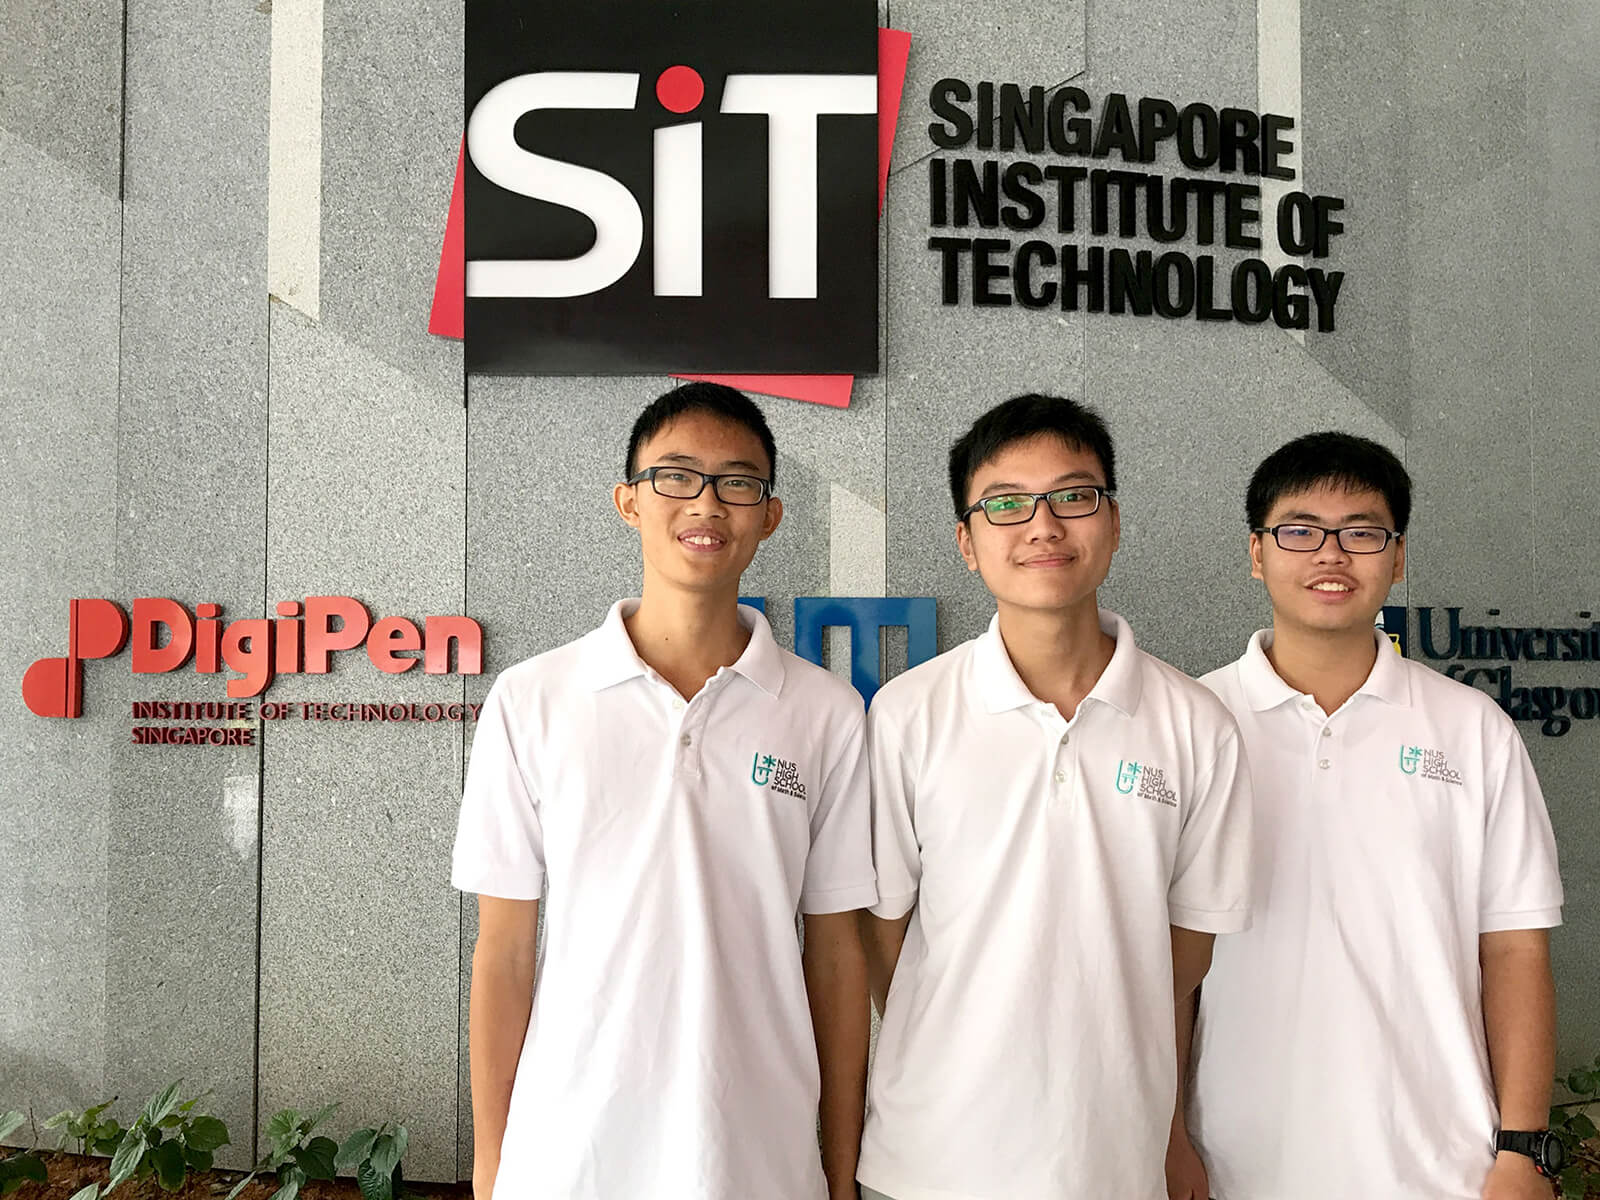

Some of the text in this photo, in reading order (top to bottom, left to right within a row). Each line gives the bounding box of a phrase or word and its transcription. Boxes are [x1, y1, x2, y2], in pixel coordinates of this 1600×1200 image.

[928, 78, 1296, 181] SINGAPORE
[929, 158, 1345, 258] INSTITUTE OF
[928, 236, 1345, 333] TECHNOLOGY
[132, 596, 484, 698] DigiPen
[132, 701, 483, 722] INSTITUTE OF TECHNOLOGY
[131, 726, 257, 747] SINGAPORE
[1423, 749, 1445, 760] NUS
[777, 758, 797, 771] NUS
[1423, 757, 1448, 769] HIGH
[775, 768, 799, 782] HIGH
[1143, 765, 1164, 779] NUS
[1423, 765, 1461, 780] SCHOOL
[1141, 776, 1166, 789] HIGH
[1139, 784, 1177, 802] SCHOOL
